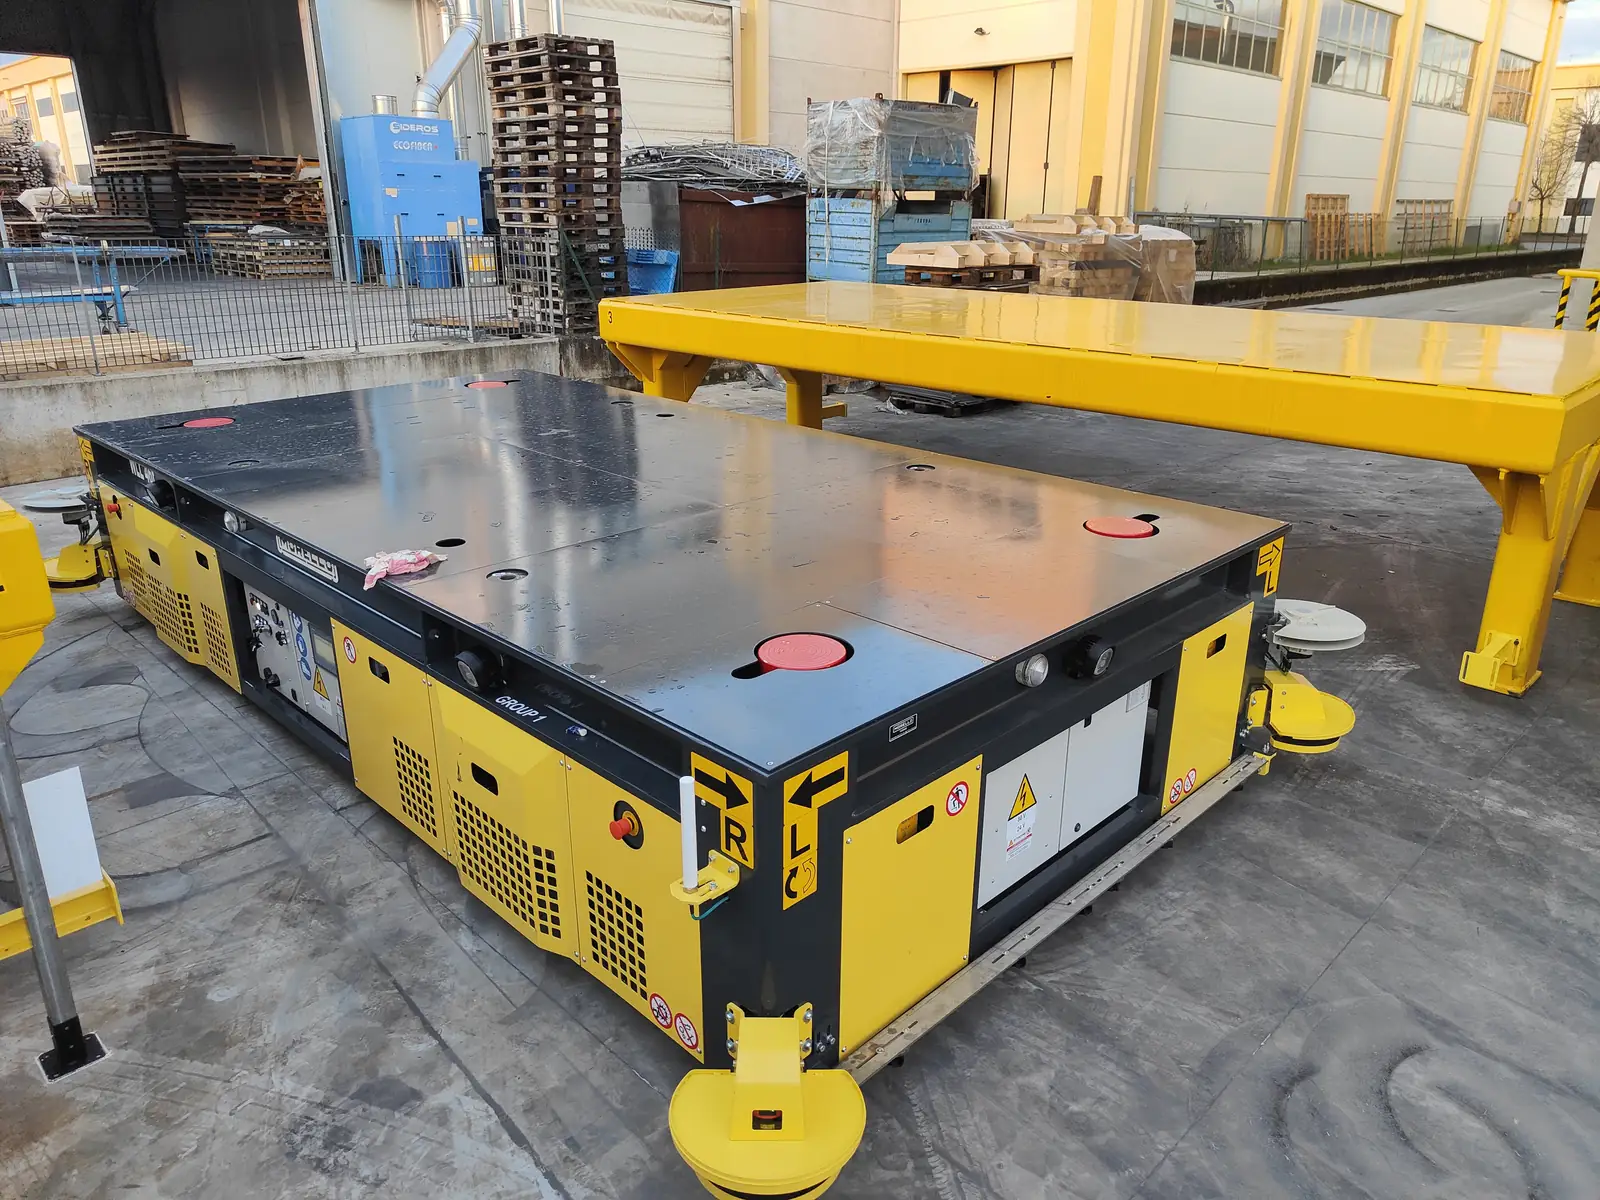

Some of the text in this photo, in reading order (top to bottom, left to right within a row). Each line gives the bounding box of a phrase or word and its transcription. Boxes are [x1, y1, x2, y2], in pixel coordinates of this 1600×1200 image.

[390, 121, 439, 134] SIDEROS
[607, 311, 613, 324] 3
[1267, 570, 1275, 593] L
[495, 696, 539, 717] GROUP
[533, 715, 548, 723] 1
[725, 816, 747, 862] R
[791, 823, 811, 860] L
